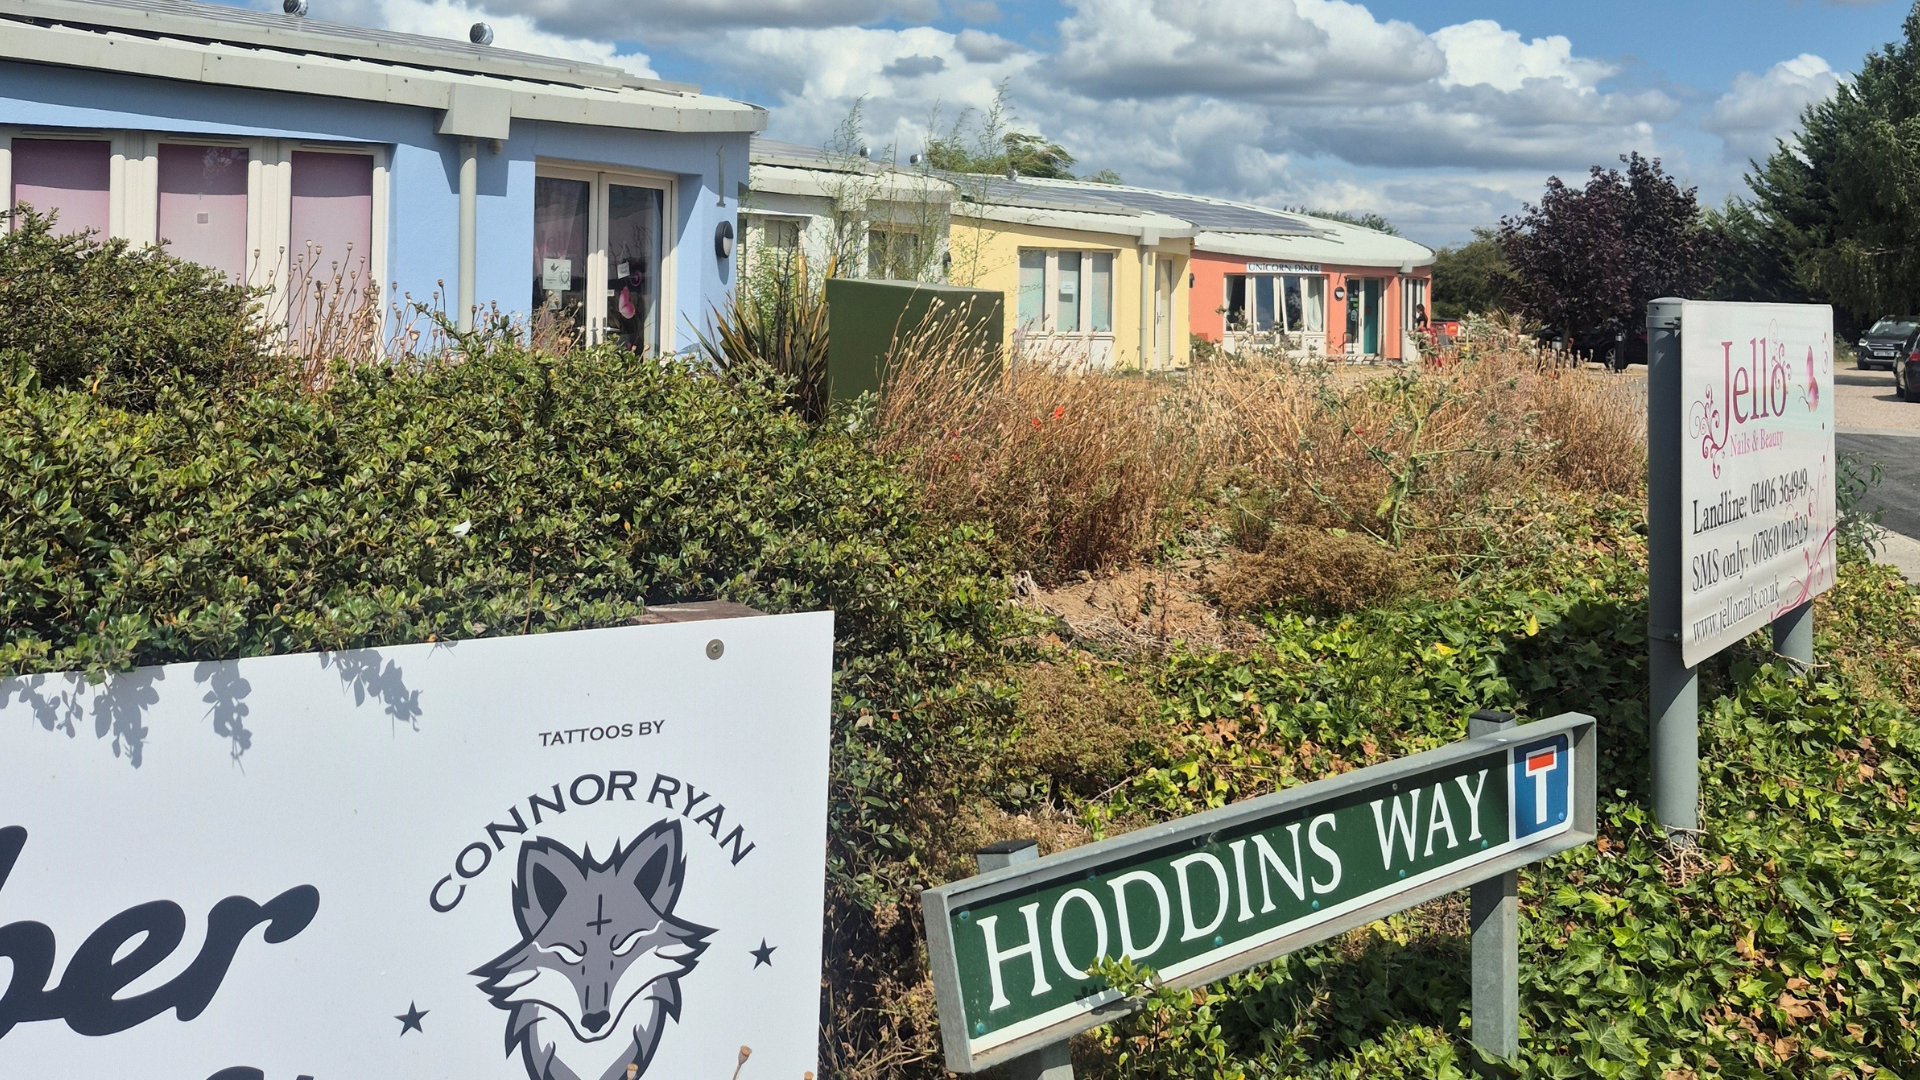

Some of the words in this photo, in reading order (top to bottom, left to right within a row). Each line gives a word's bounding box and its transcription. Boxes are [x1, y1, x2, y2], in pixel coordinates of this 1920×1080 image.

[1706, 336, 1788, 451] Jello
[1730, 432, 1750, 457] Nails
[1752, 430, 1759, 452] &
[1760, 428, 1784, 451] Beauty
[1692, 489, 1748, 535] Landline:
[1750, 477, 1777, 515] 01406
[1779, 467, 1808, 505] 364949
[1692, 548, 1719, 592] SMS
[1722, 540, 1749, 580] only:
[1751, 525, 1779, 565] 07860
[1781, 513, 1809, 552] 021329
[1692, 573, 1781, 643] www.jellonails.co.uk
[538, 723, 634, 747] TATTOOS
[638, 719, 666, 736] BY
[429, 770, 638, 913] CONNOR
[646, 773, 757, 867] RYAN
[975, 812, 1342, 1012] HODDINS
[1369, 768, 1489, 871] WAY
